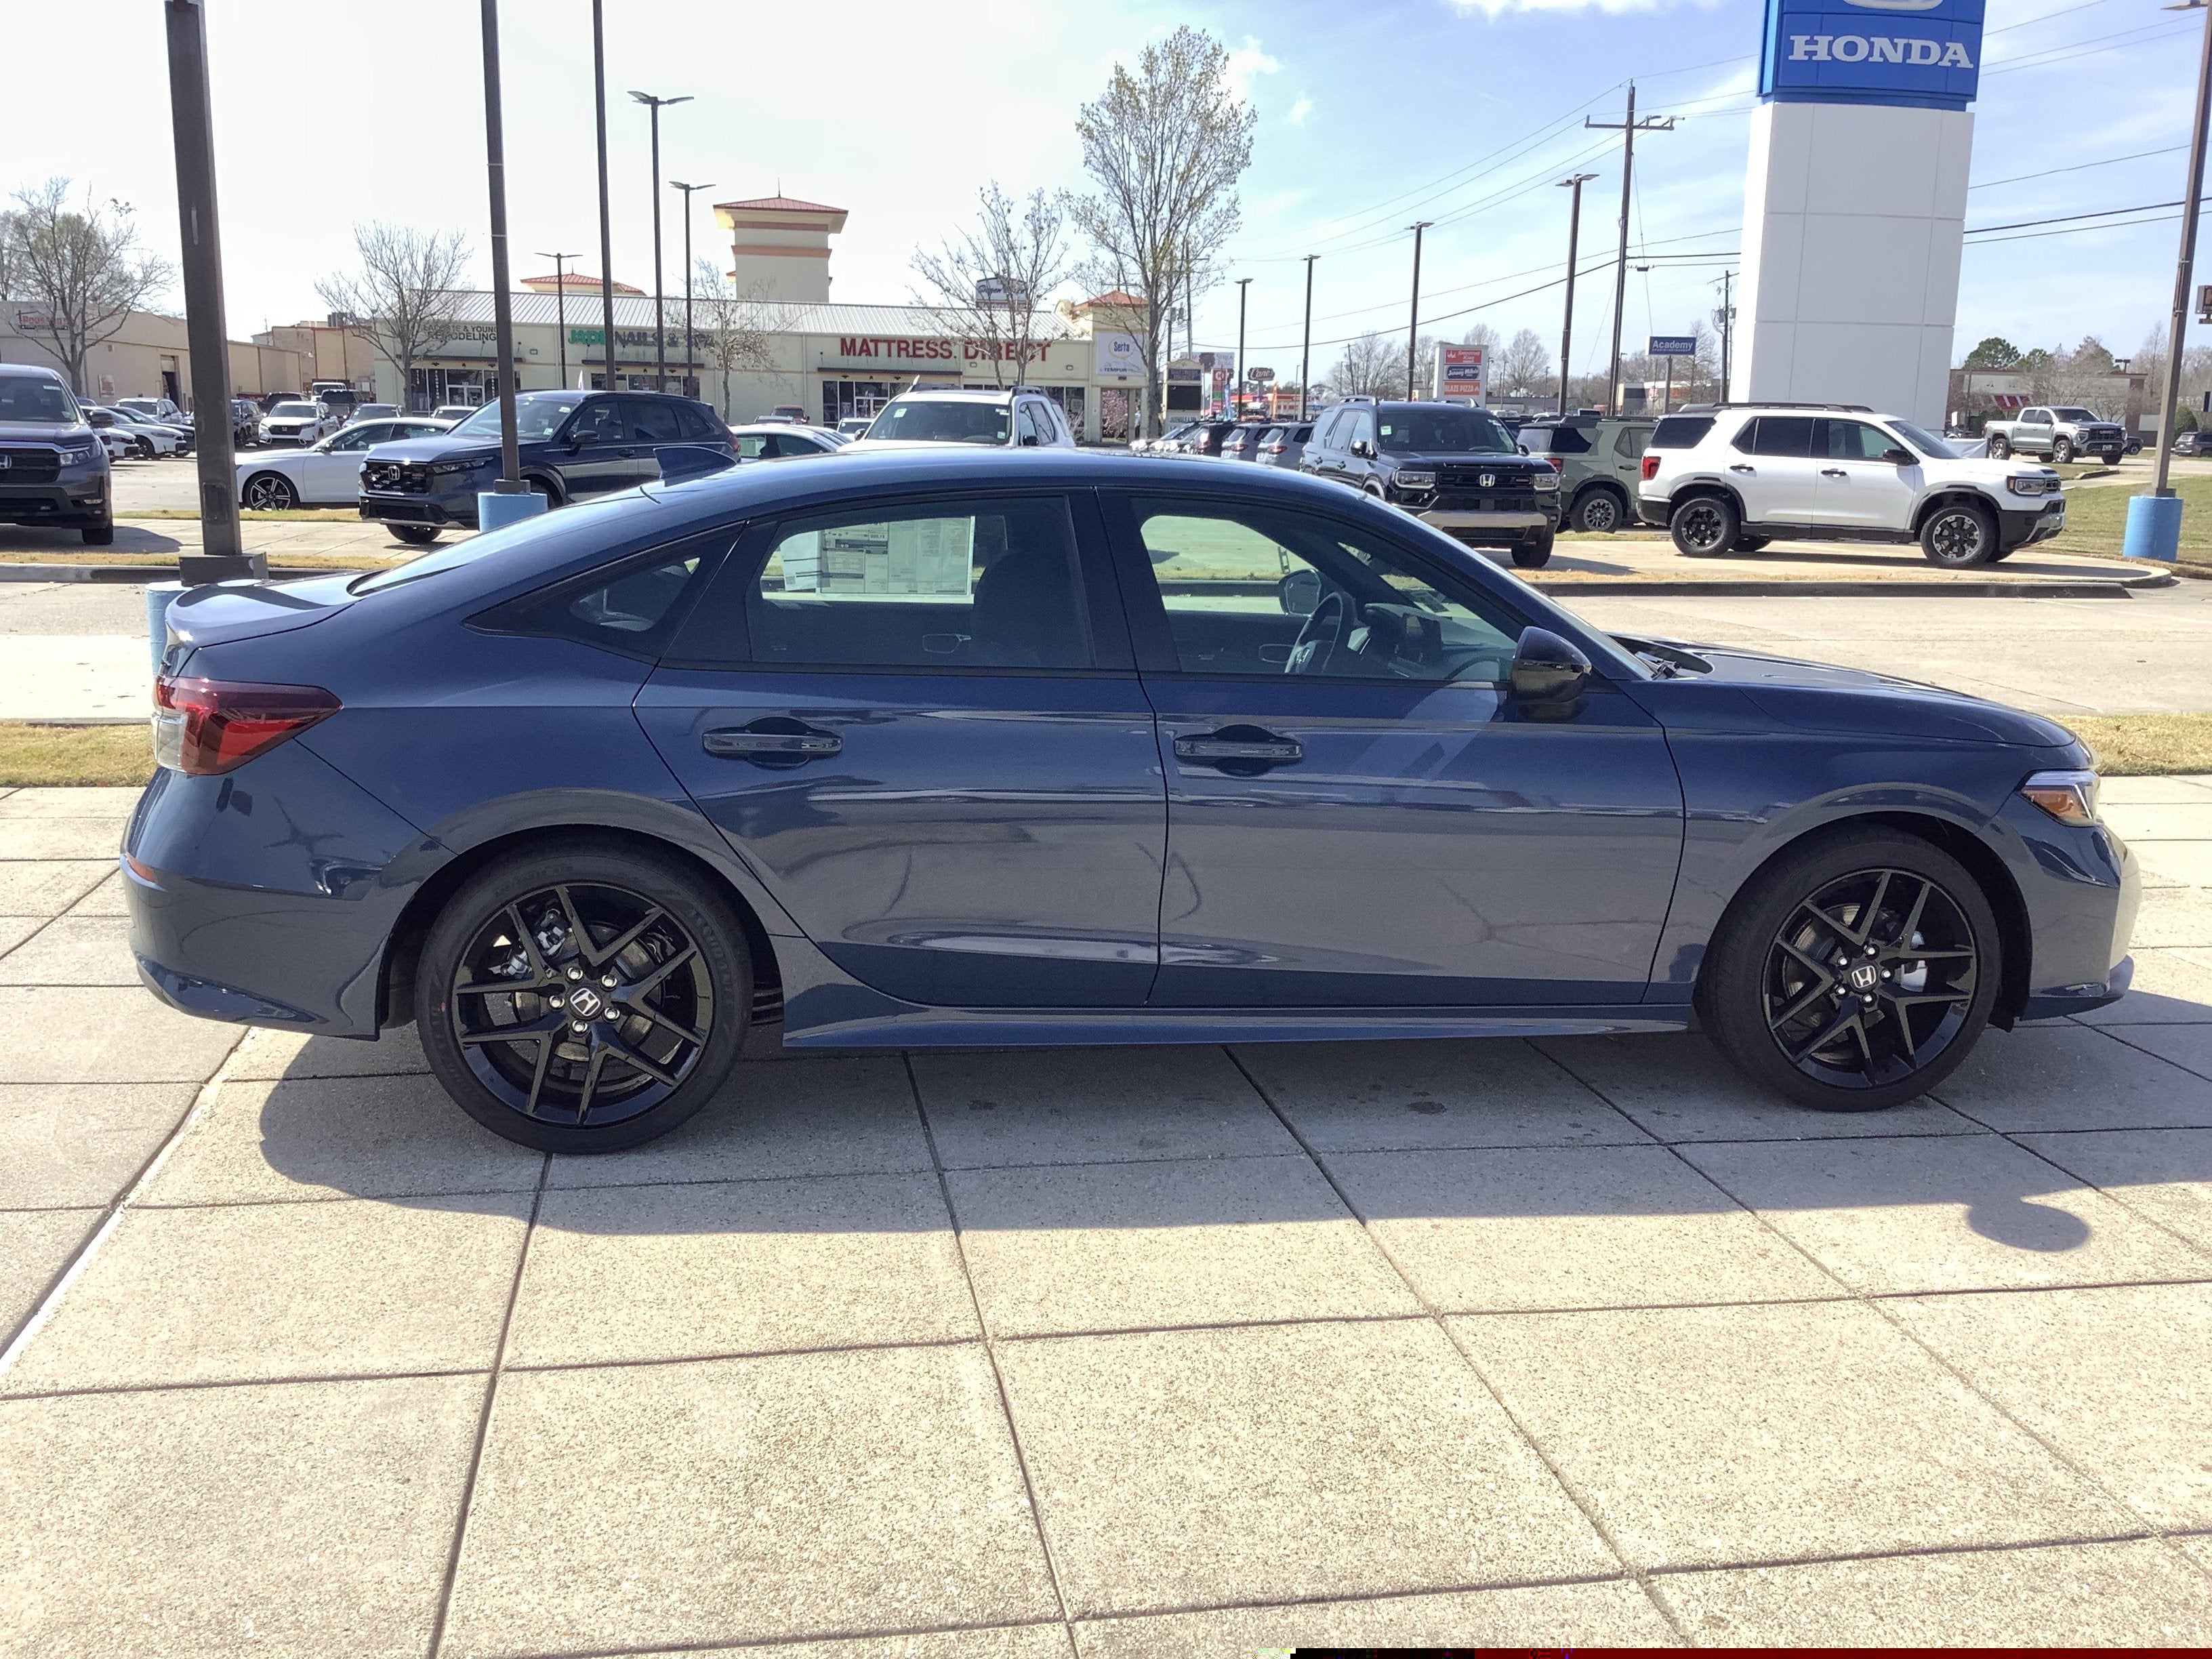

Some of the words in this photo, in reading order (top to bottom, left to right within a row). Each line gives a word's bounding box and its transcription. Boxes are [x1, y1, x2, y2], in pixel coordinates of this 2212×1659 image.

[1788, 35, 1974, 69] HONDA
[568, 329, 606, 346] JADE
[840, 337, 953, 359] MATTRESS
[964, 340, 1051, 361] DIRECT
[1113, 341, 1130, 352] Serta
[1652, 340, 1694, 351] Academy
[1460, 384, 1474, 392] PIZZA
